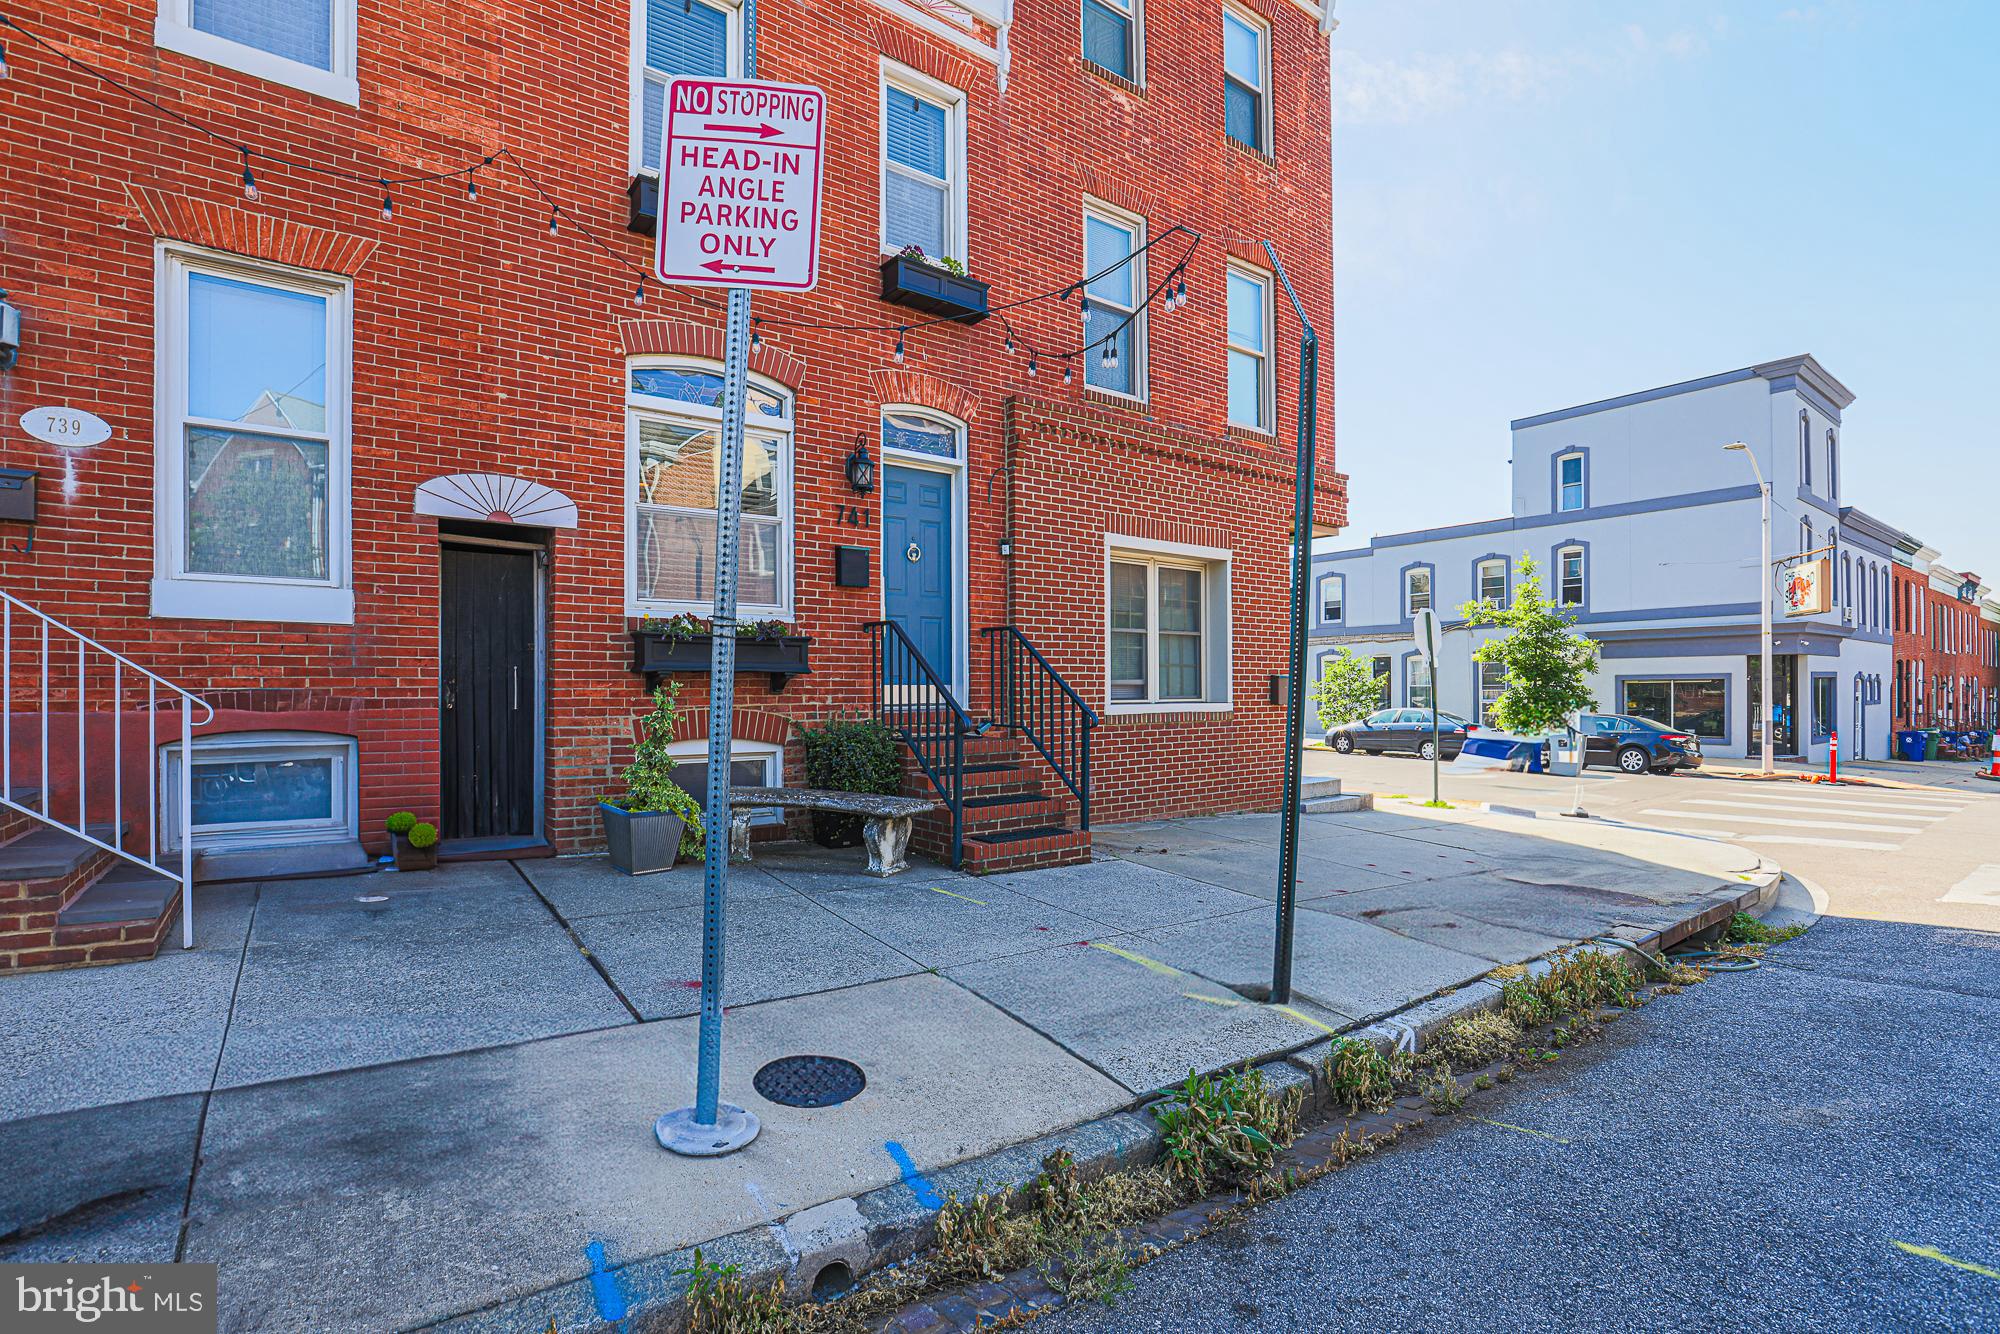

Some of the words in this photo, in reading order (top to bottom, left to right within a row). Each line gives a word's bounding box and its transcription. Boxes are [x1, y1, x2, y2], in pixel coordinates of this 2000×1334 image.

[675, 85, 709, 112] NO
[717, 89, 815, 122] STOPPING
[680, 145, 800, 175] HEAD-IN
[698, 175, 785, 202] ANGLE
[680, 202, 799, 231] PARKING
[700, 233, 777, 258] ONLY
[47, 416, 81, 435] 739
[831, 504, 870, 528] 741
